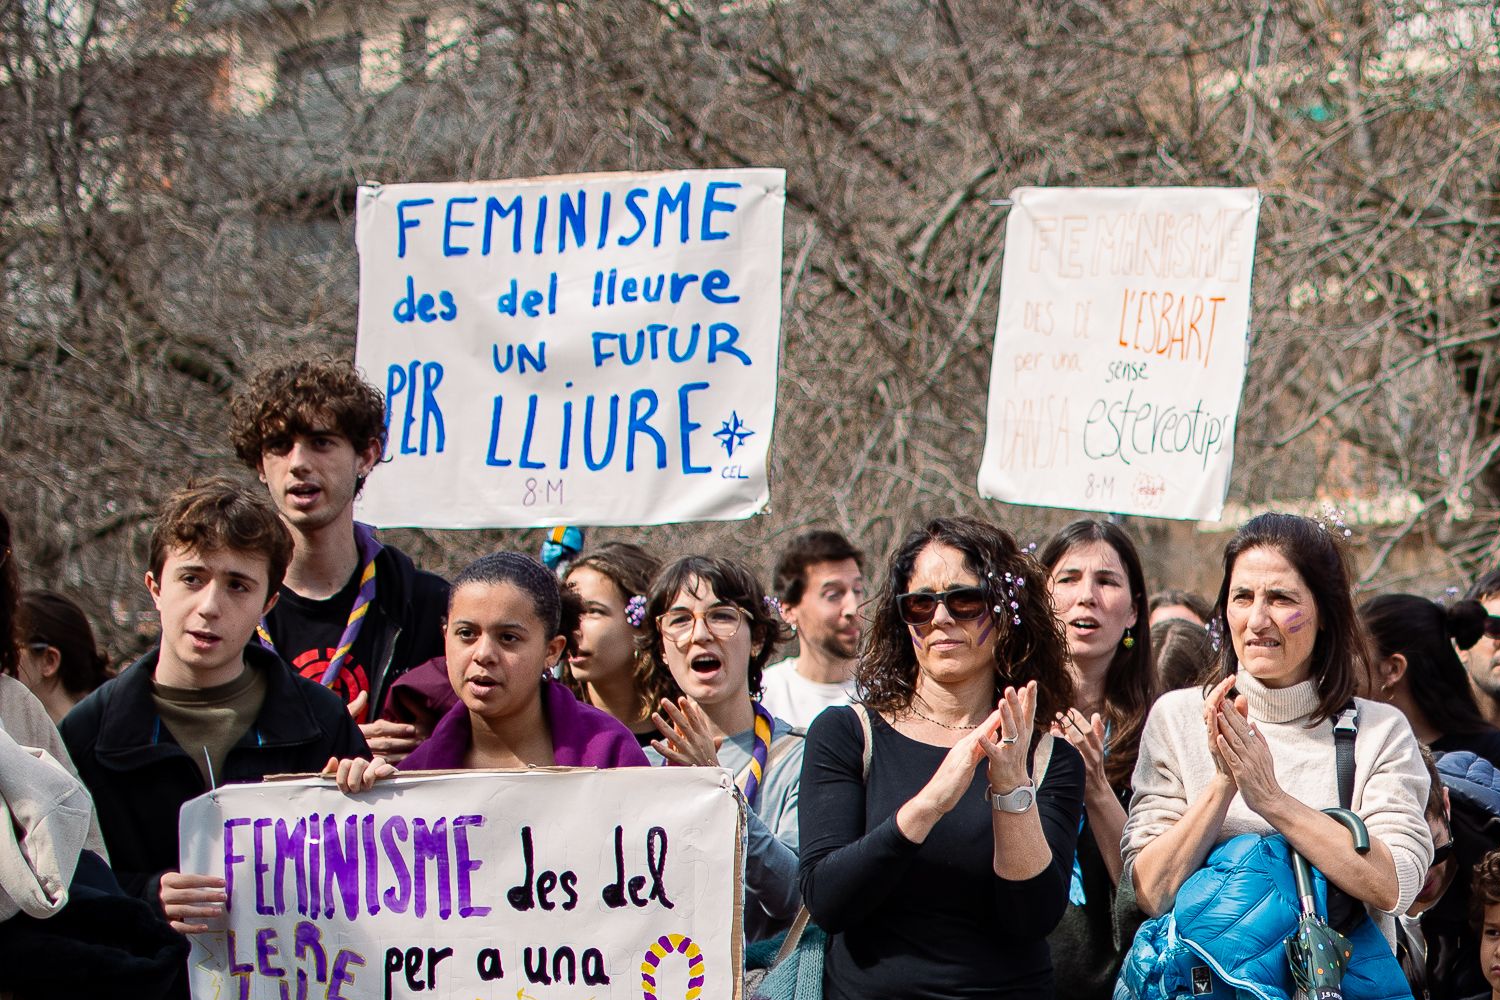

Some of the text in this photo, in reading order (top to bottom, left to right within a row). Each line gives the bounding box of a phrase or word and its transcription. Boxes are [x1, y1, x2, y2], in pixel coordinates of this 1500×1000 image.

[397, 181, 743, 258] FEMINISME
[393, 268, 741, 324] des del lleure
[1023, 300, 1055, 337] DES
[1119, 287, 1227, 369] L'ESBART
[382, 322, 753, 459] PER UN FUTUR
[1013, 352, 1045, 388] per
[1104, 358, 1150, 384] sense
[720, 464, 750, 480] CEL
[506, 826, 578, 912] des
[601, 824, 674, 910] del
[476, 946, 505, 984] a
[522, 944, 611, 987] una
